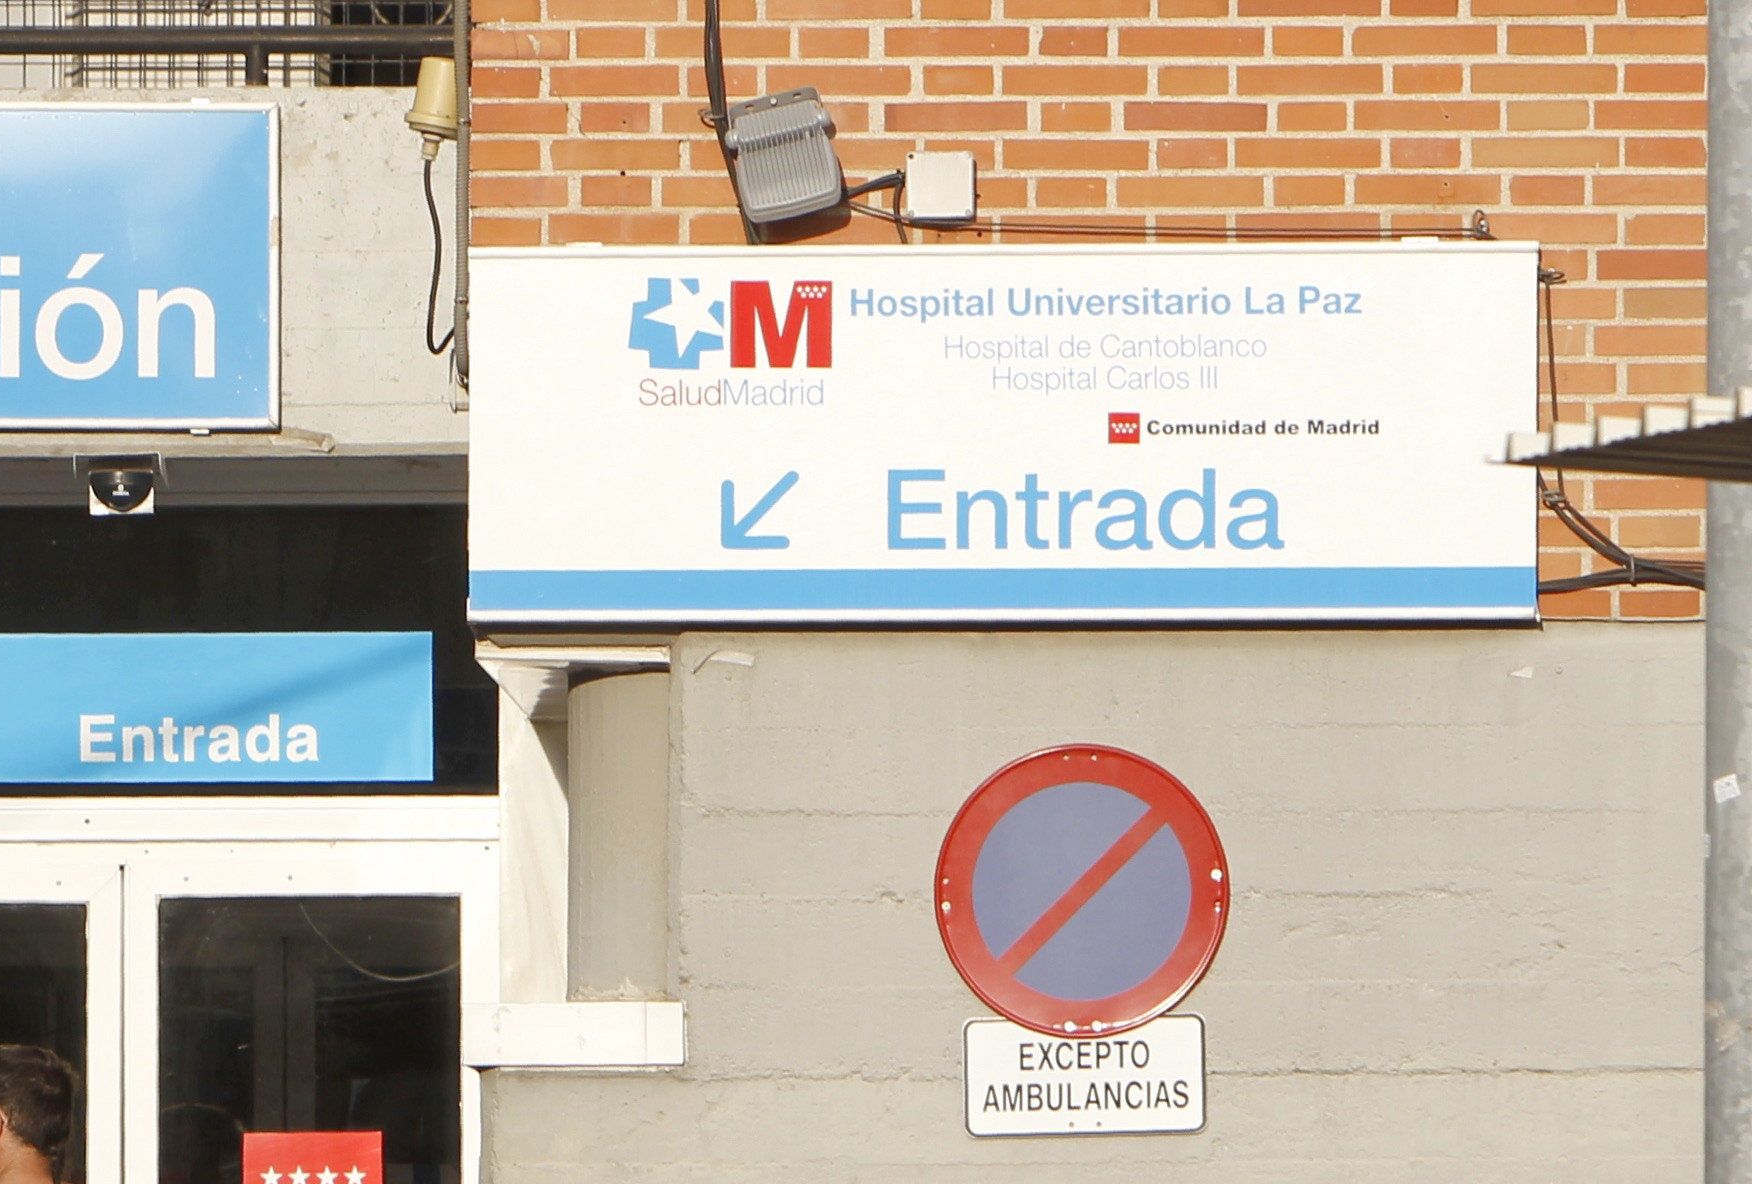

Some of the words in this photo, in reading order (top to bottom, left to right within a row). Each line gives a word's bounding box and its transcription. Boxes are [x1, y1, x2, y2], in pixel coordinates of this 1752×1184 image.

[850, 287, 994, 323] Hospital
[1007, 286, 1232, 317] Universitario
[1244, 286, 1285, 315] La
[1298, 285, 1363, 315] Paz
[730, 280, 833, 369] M
[944, 334, 1049, 364] Hospital
[1058, 334, 1091, 359] de
[1100, 333, 1268, 359] Cantoblanco
[638, 377, 825, 407] SaludMadrid
[992, 365, 1097, 396] Hospital
[1106, 365, 1190, 391] Carlos
[1199, 365, 1218, 390] III
[1146, 420, 1267, 436] Comunidad
[1274, 420, 1300, 435] de
[1307, 419, 1380, 436] Madrid
[886, 467, 1286, 552] Entrada
[78, 712, 320, 765] Entrada
[1019, 1040, 1150, 1071] EXCEPTO
[982, 1079, 1190, 1113] AMBULANCIAS
